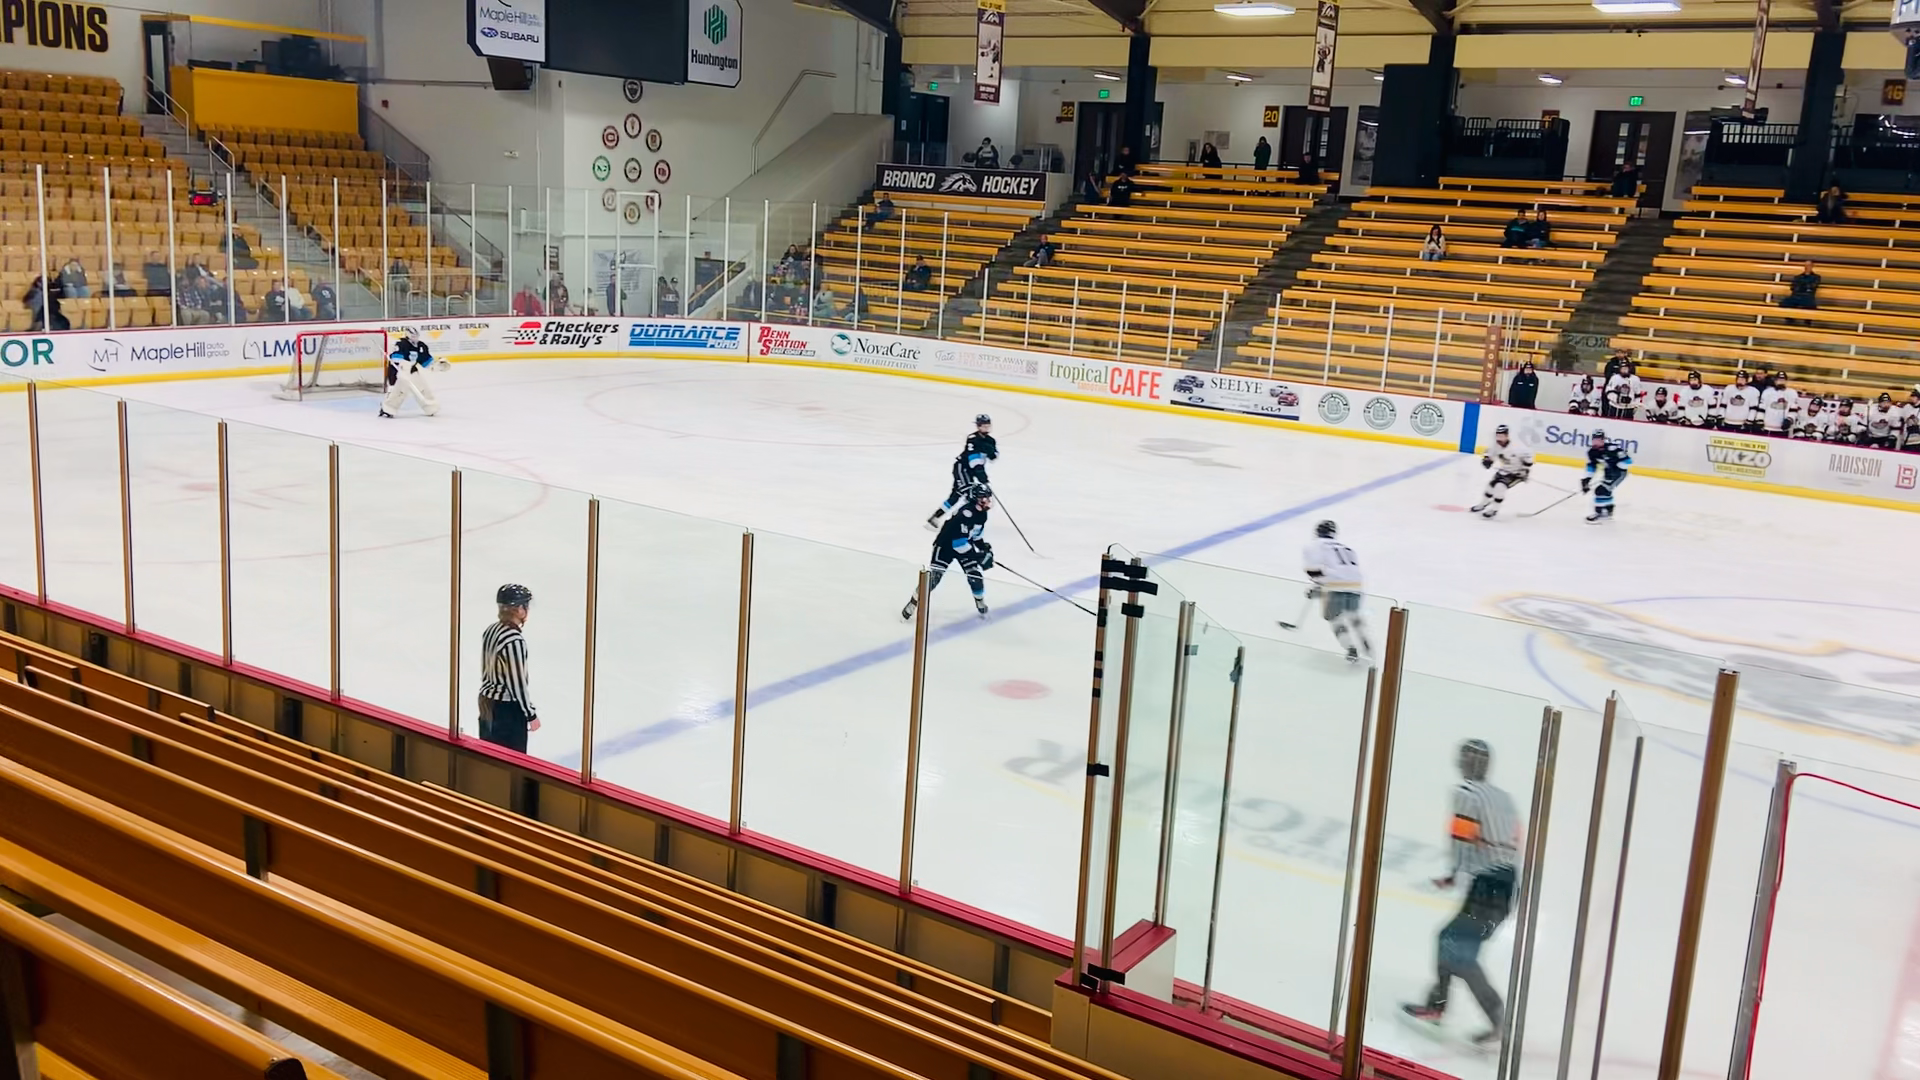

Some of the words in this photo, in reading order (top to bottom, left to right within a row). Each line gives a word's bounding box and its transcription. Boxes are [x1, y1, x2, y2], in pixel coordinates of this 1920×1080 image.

[3, 0, 108, 53] PIONS
[500, 31, 539, 43] SUBARU
[691, 49, 738, 71] Huntington
[1062, 106, 1074, 117] 22
[1265, 111, 1278, 123] 20
[882, 169, 936, 190] BRONCO
[982, 175, 1039, 196] HOCKEY
[545, 321, 619, 333] Checkers
[630, 324, 741, 340] DURRANCE
[757, 326, 790, 343] PENN
[206, 342, 225, 350] auto
[539, 334, 549, 345] &
[550, 333, 603, 348] Rally's
[707, 340, 740, 349] FORD
[760, 339, 808, 355] STATION
[854, 338, 921, 360] NovaCare
[0, 338, 54, 367] OR
[206, 350, 230, 359] group
[978, 353, 1001, 362] STEPS
[1003, 356, 1025, 365] AWAY
[854, 356, 918, 370] REHABILITATION
[1049, 361, 1109, 384] tropical
[1109, 367, 1163, 399] CAFE
[1210, 377, 1263, 395] SEELYE
[1545, 425, 1638, 454] Schuan
[1708, 446, 1770, 468] WKZO
[1829, 453, 1882, 477] RADISSON
[1895, 463, 1918, 489] B
